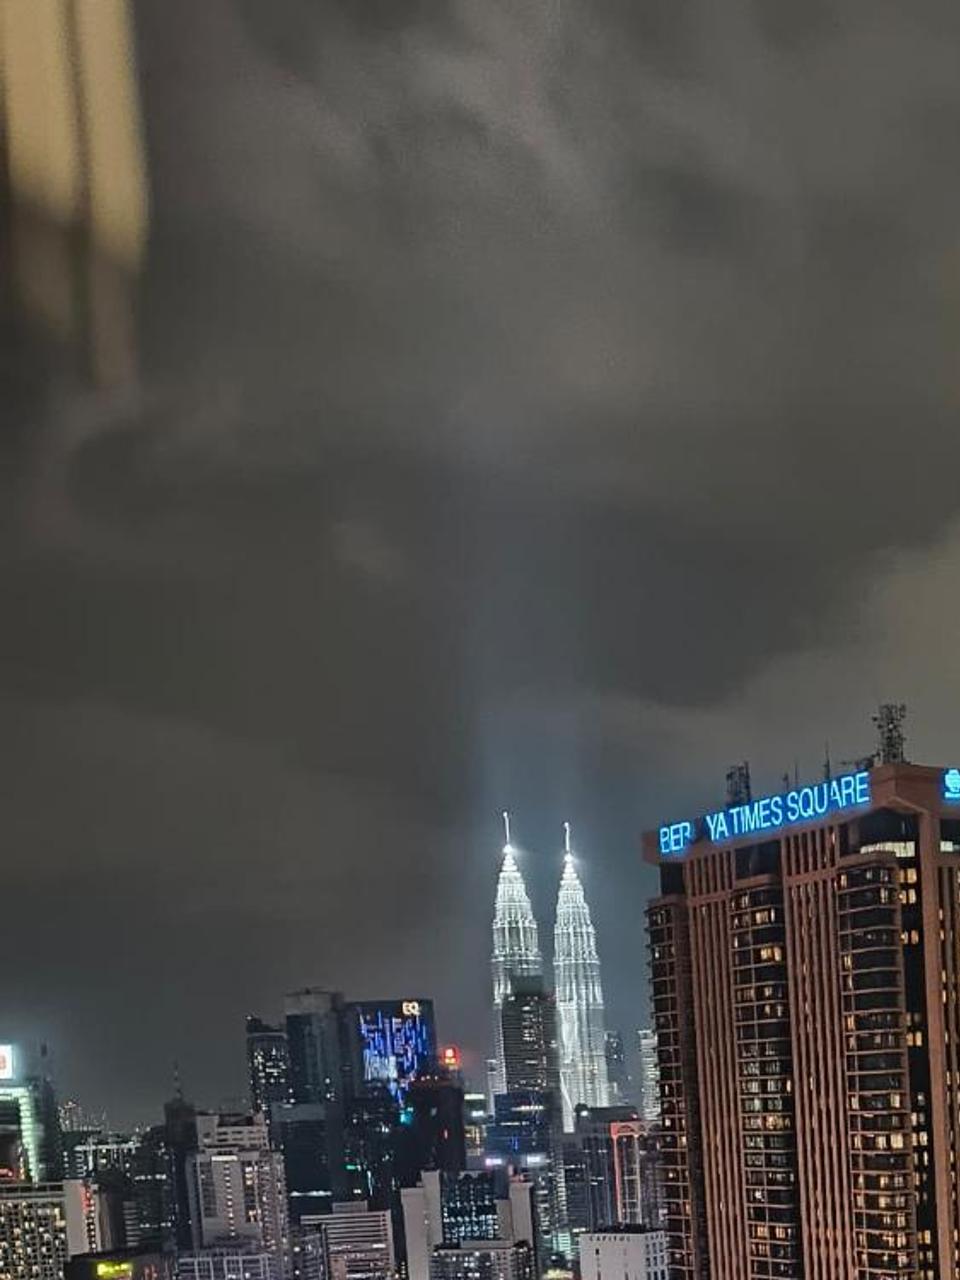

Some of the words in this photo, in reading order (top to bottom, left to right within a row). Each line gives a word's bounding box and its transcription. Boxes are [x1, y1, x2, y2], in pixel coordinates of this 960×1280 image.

[729, 796, 782, 834] TIMES
[787, 771, 870, 821] SQUARE
[402, 1001, 420, 1015] EQ
